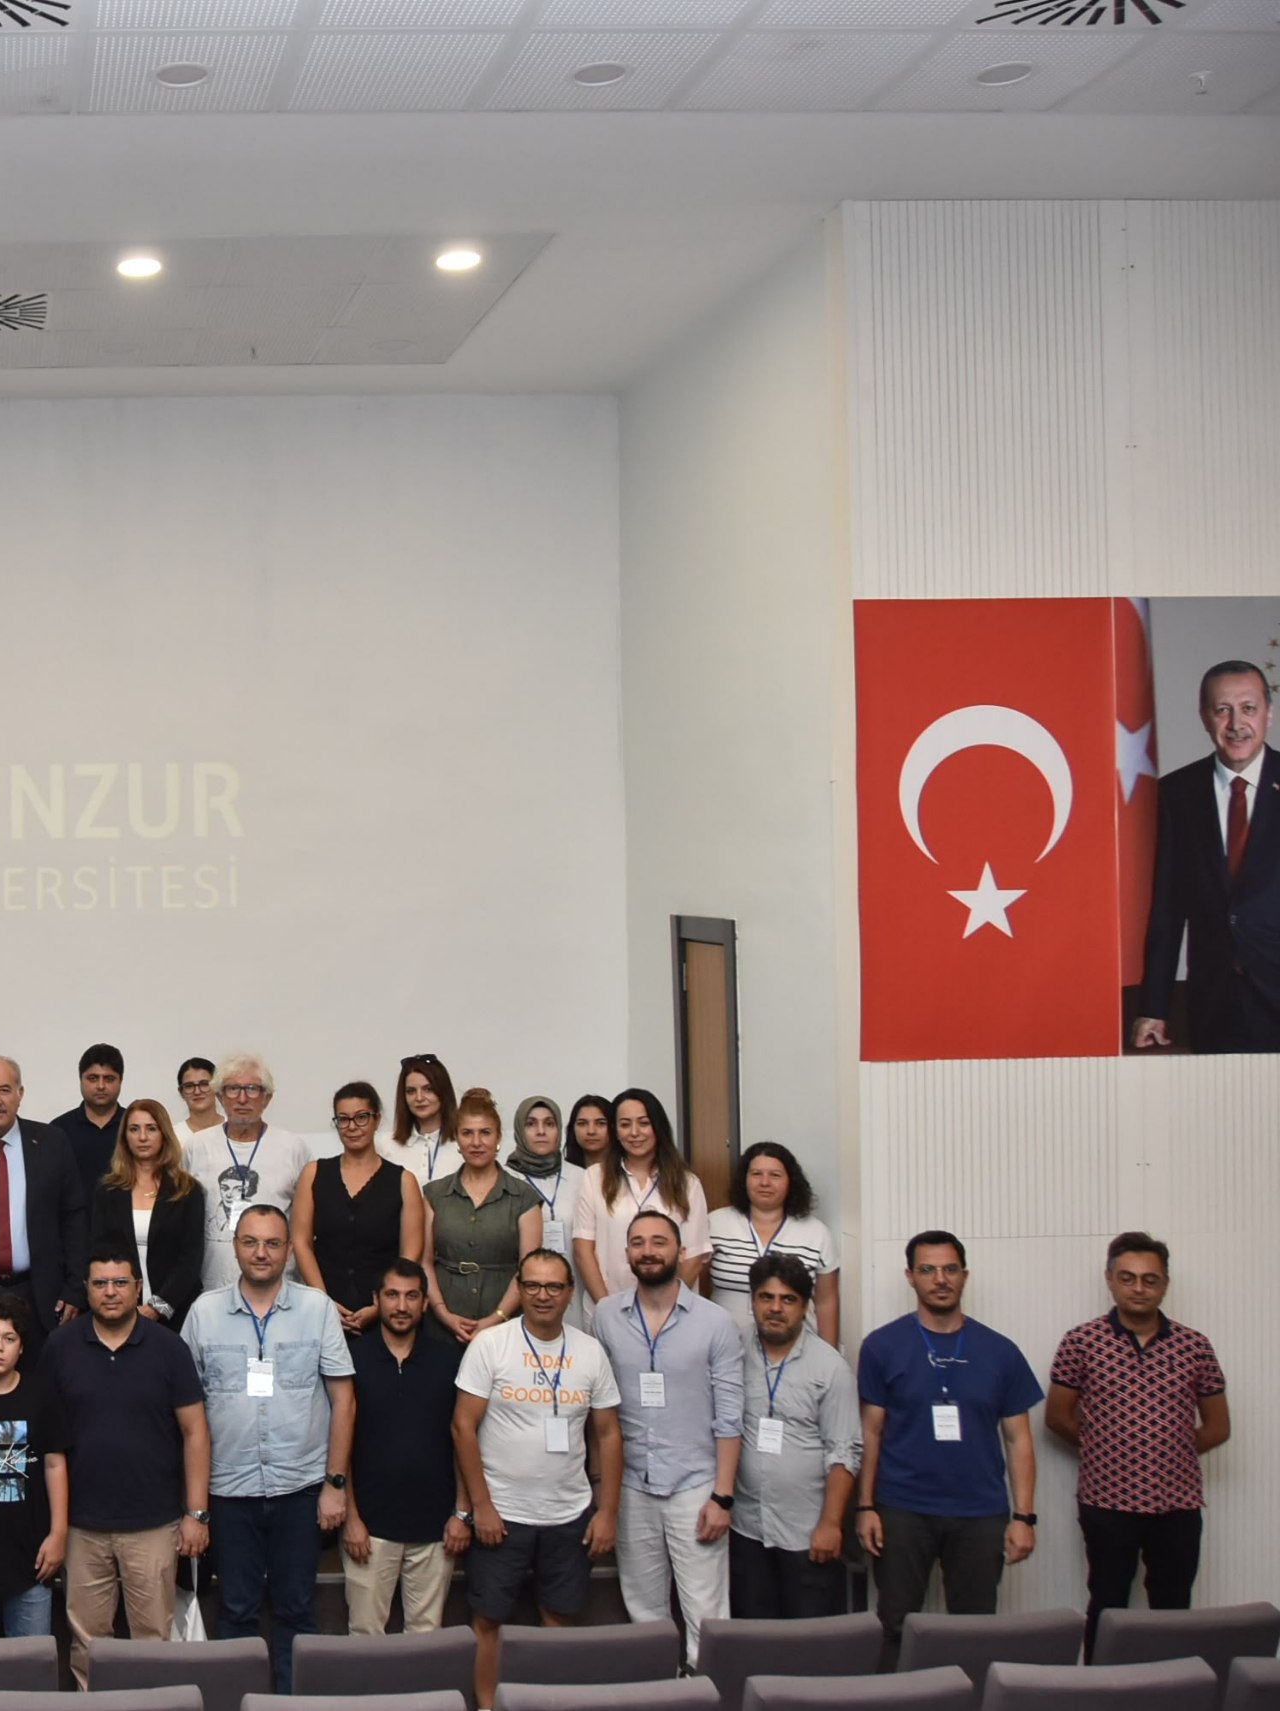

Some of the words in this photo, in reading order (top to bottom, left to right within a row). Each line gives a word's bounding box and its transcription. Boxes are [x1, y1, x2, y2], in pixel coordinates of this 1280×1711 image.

[522, 1352, 573, 1369] TODAY
[533, 1371, 546, 1386] IS
[500, 1385, 554, 1403] GOOD
